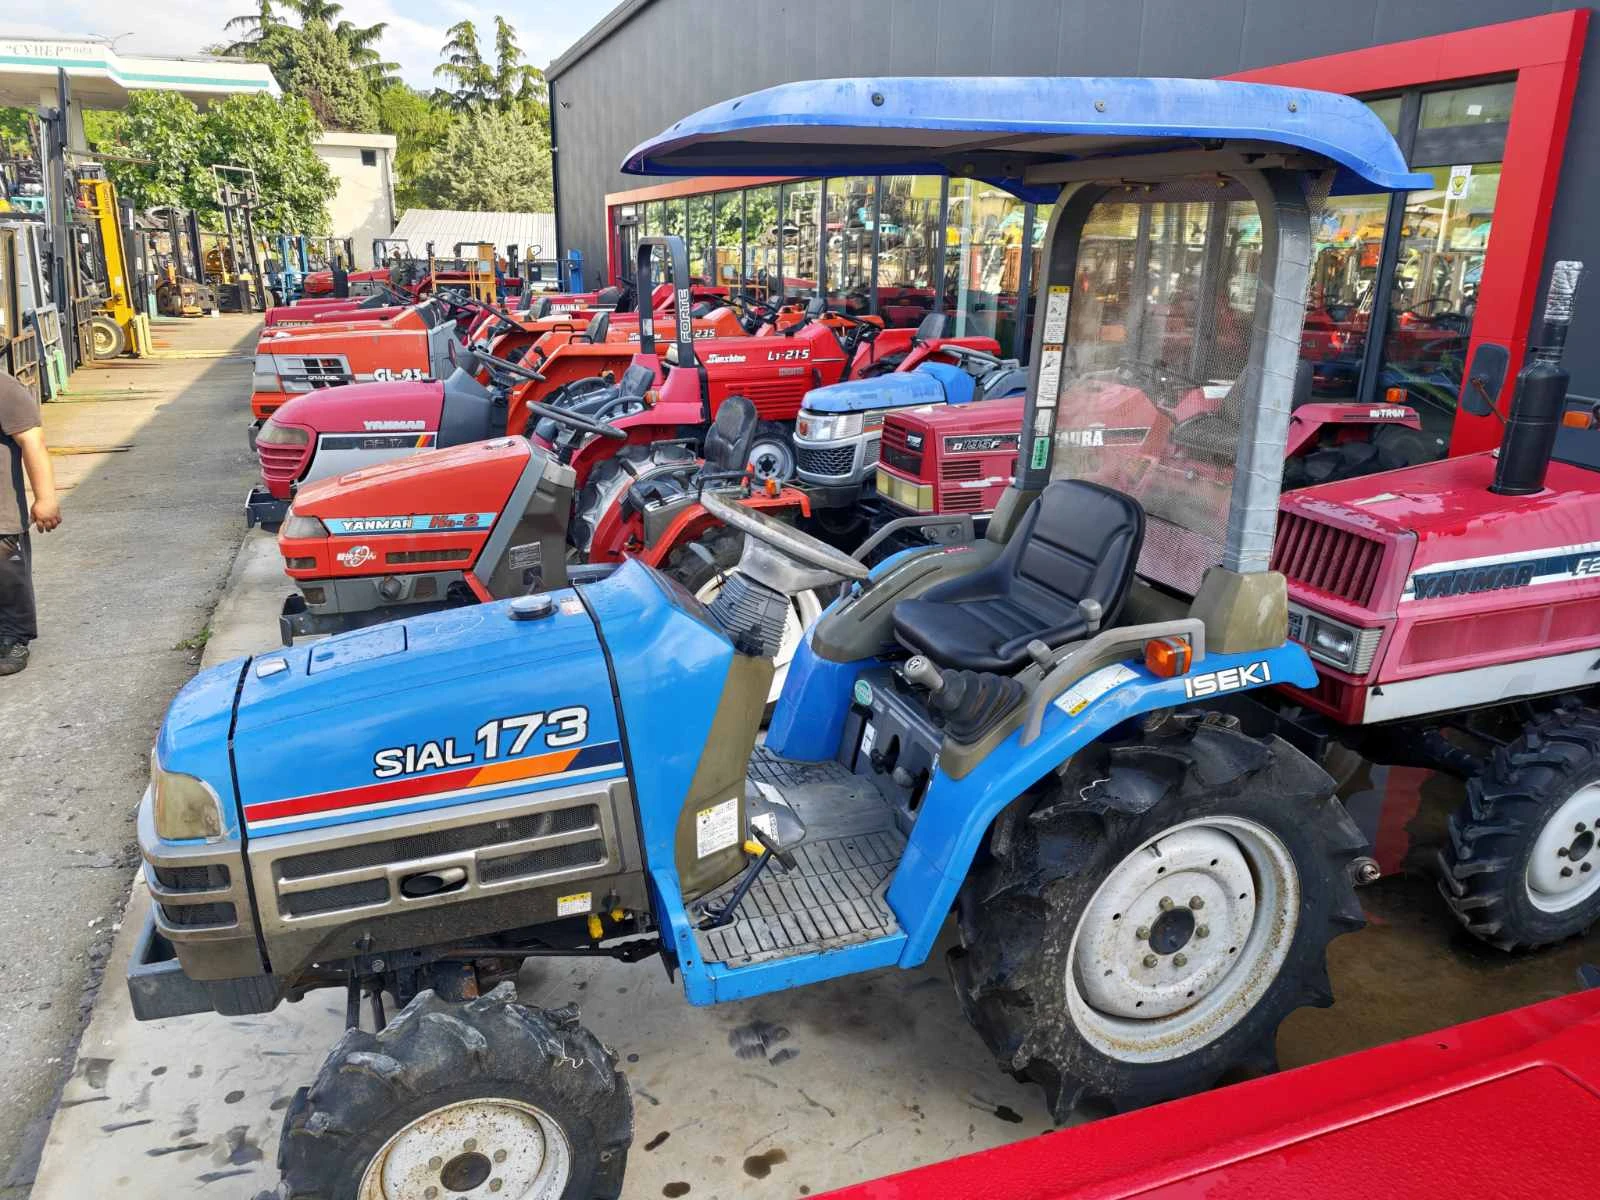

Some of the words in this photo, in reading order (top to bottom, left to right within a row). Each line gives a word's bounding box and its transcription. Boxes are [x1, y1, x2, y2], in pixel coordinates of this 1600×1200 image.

[678, 288, 691, 343] FORTE
[363, 420, 426, 431] YANMAR
[343, 518, 413, 531] YANMAR
[1414, 562, 1537, 600] YANMAR
[1184, 660, 1272, 699] ISEKI
[374, 736, 475, 779] SIAL
[475, 704, 589, 760] 173
